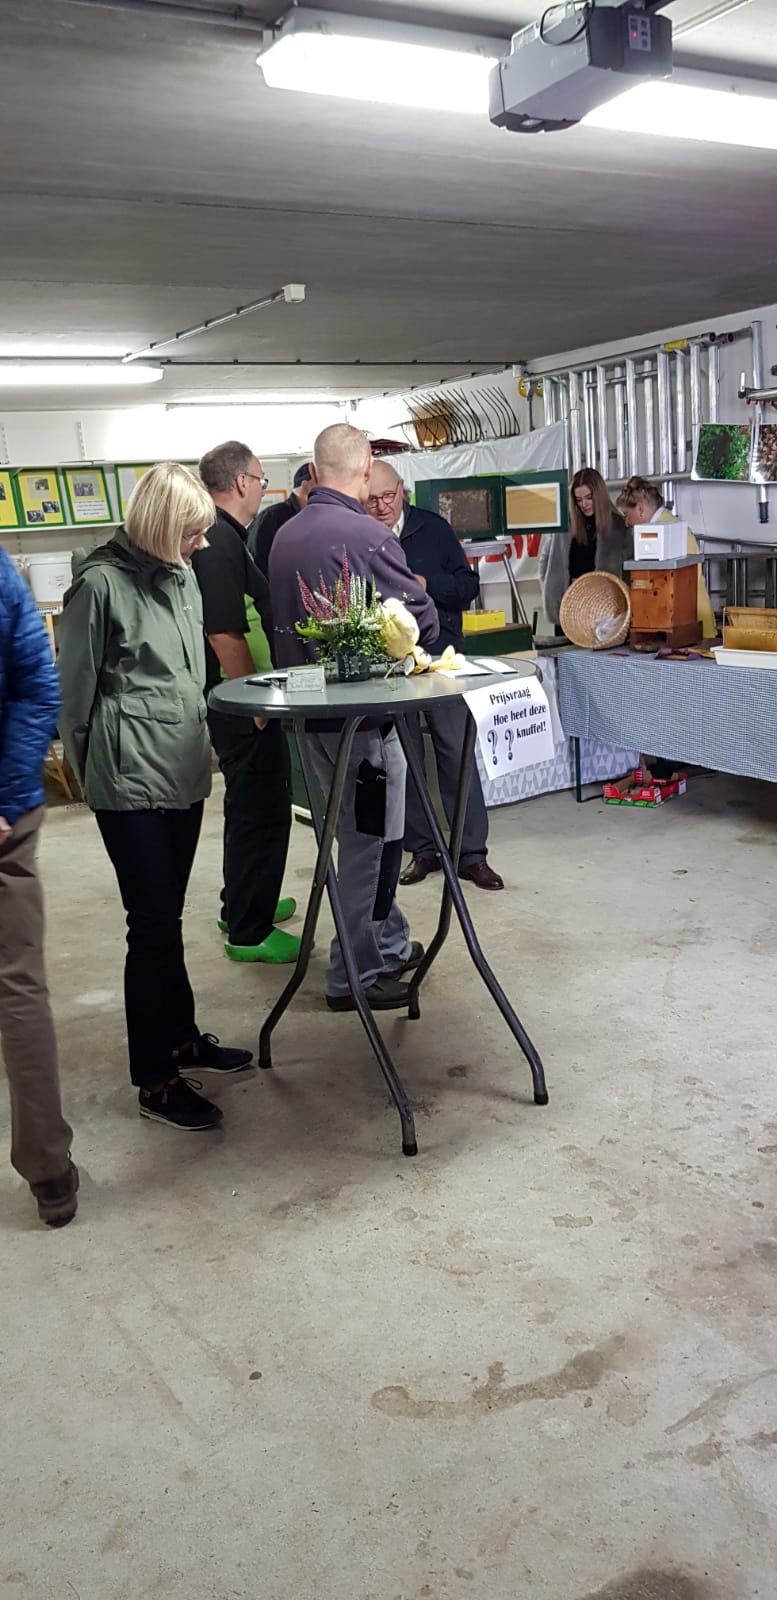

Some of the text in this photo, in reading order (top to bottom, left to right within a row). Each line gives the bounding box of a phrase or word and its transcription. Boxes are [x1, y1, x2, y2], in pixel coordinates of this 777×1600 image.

[489, 686, 532, 705] Prijsvraag
[493, 704, 546, 726] Hoe heet deze
[516, 721, 547, 739] knuffel!
[487, 728, 515, 766] ? ?
